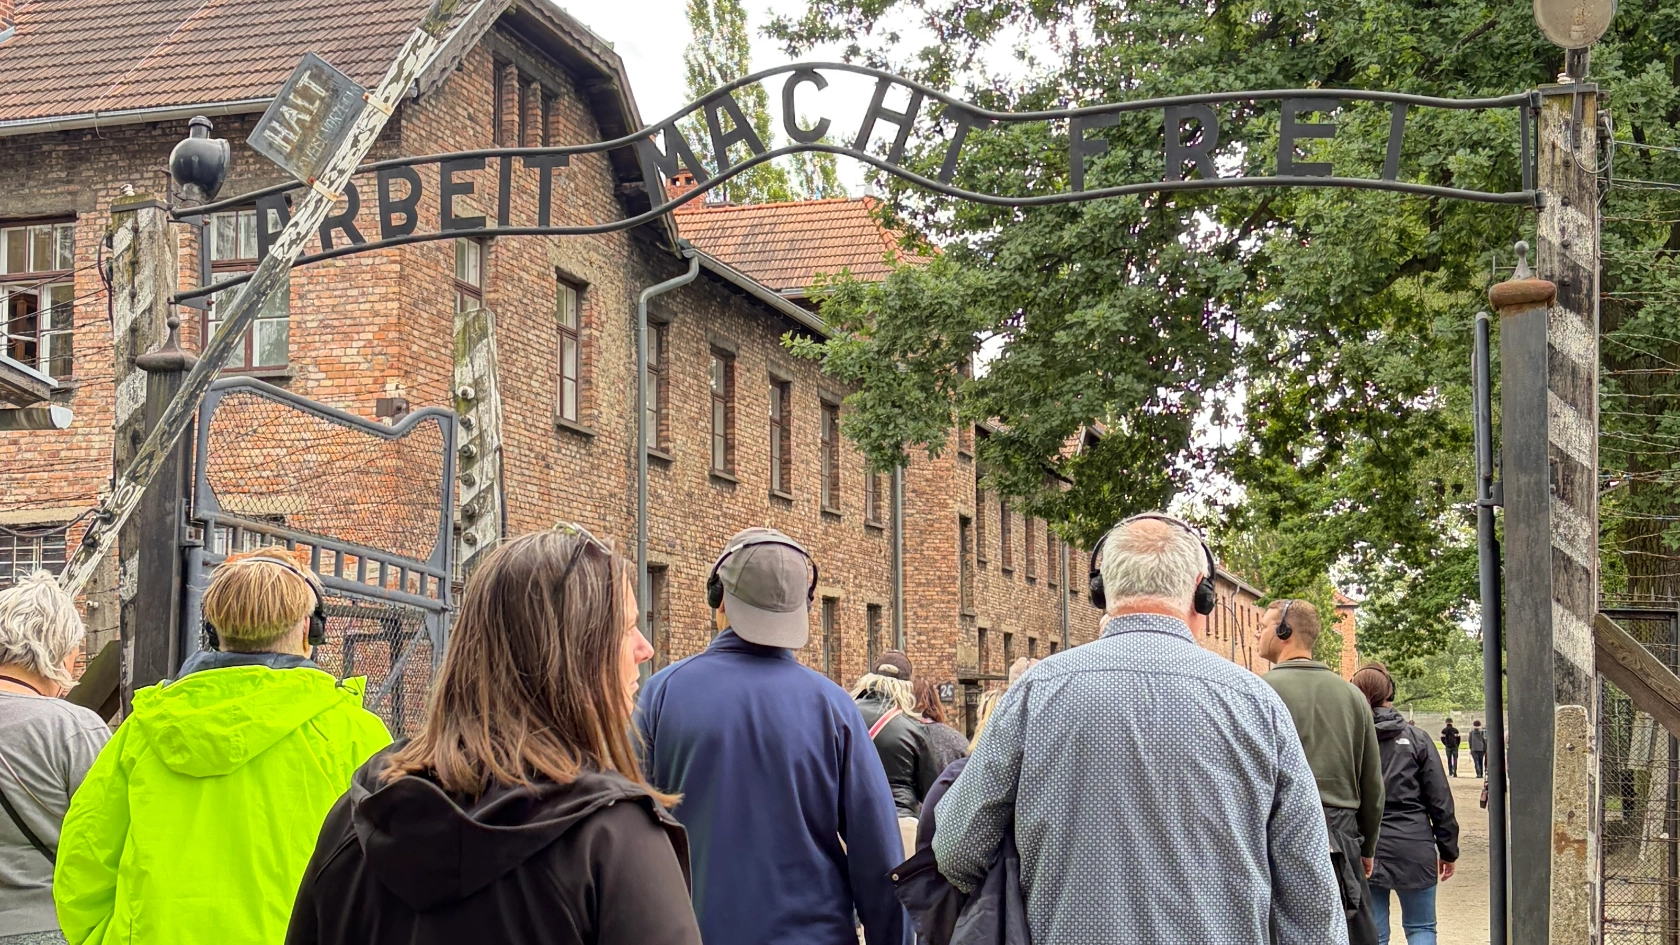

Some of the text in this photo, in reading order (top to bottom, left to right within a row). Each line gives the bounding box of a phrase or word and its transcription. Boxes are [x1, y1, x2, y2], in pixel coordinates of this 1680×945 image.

[256, 69, 1407, 262] ARBEIT MACHT FREI
[262, 69, 328, 153] HALT
